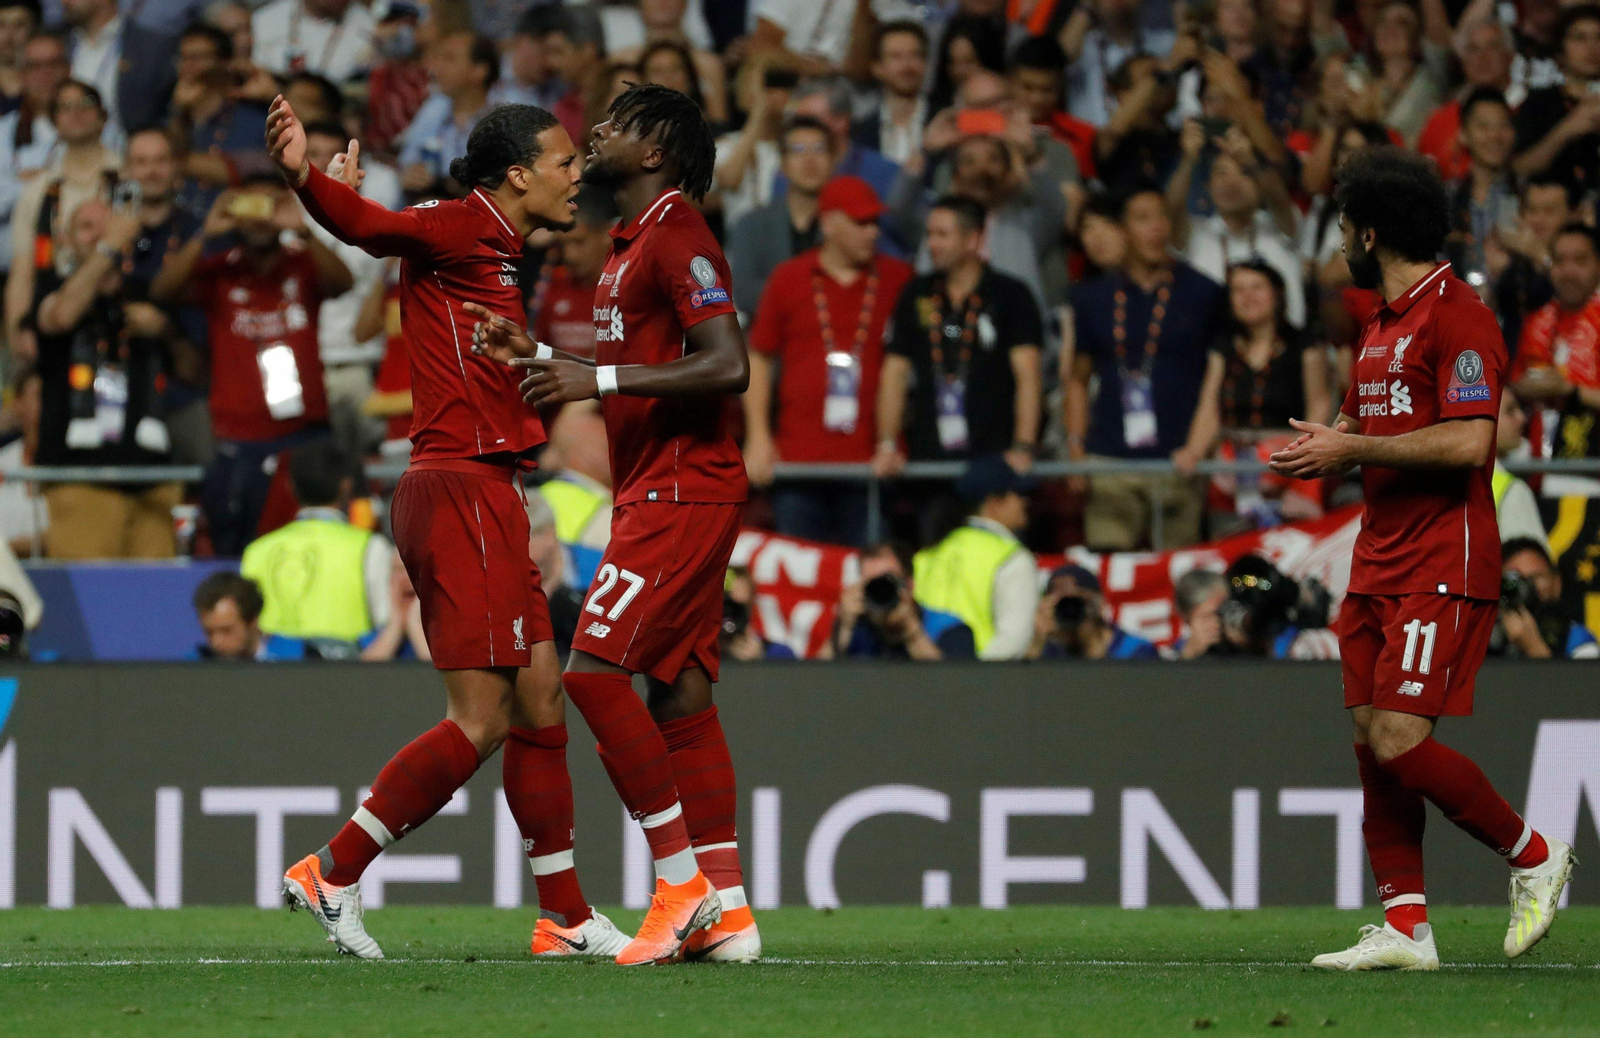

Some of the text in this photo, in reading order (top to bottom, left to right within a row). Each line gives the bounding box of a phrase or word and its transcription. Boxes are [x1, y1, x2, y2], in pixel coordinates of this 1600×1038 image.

[1358, 378, 1387, 396] andard
[1460, 389, 1489, 398] RESPEC
[1359, 399, 1388, 417] artered
[585, 563, 646, 622] 27
[1401, 619, 1437, 675] 11
